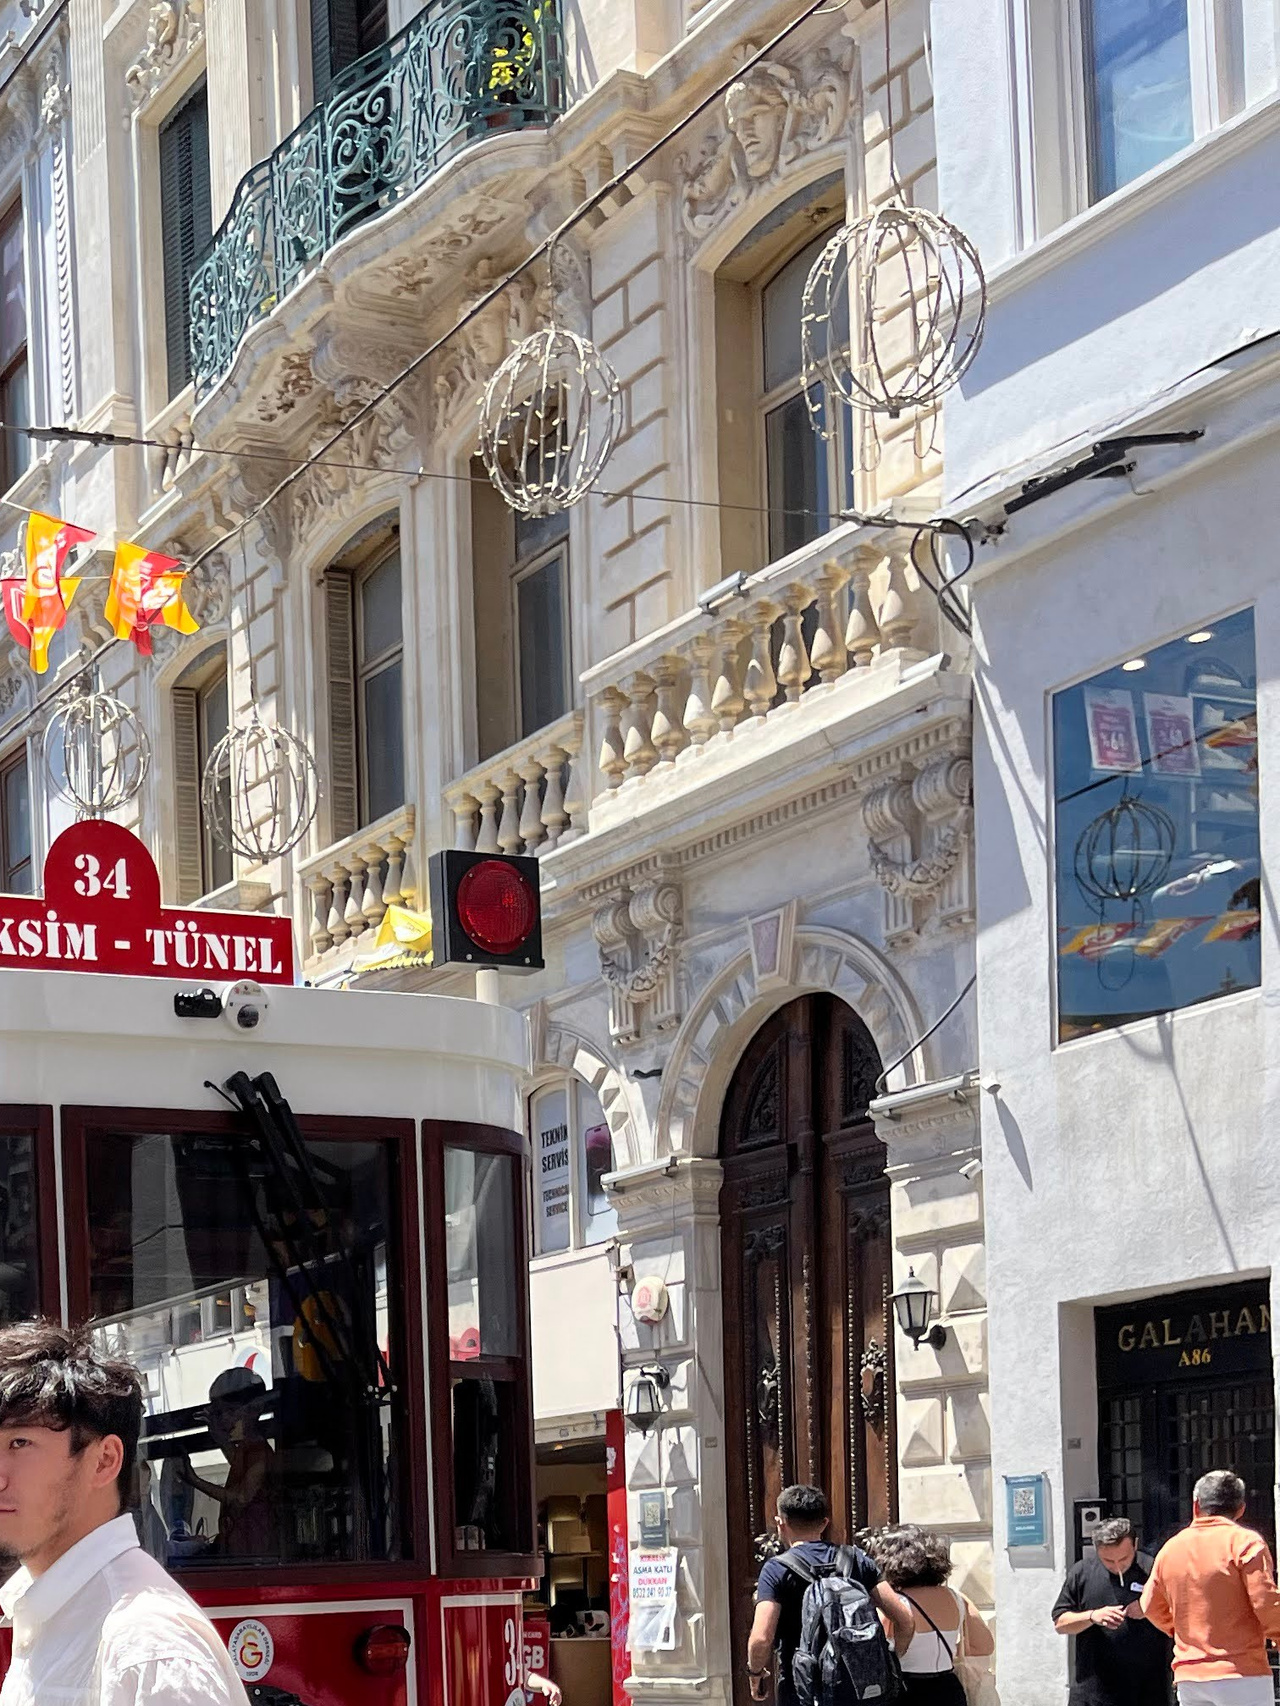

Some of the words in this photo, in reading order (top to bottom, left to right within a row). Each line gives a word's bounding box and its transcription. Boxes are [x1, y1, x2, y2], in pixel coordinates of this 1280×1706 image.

[74, 853, 131, 899] 34
[146, 920, 283, 974] TÜNEL
[1178, 1348, 1212, 1368] A86
